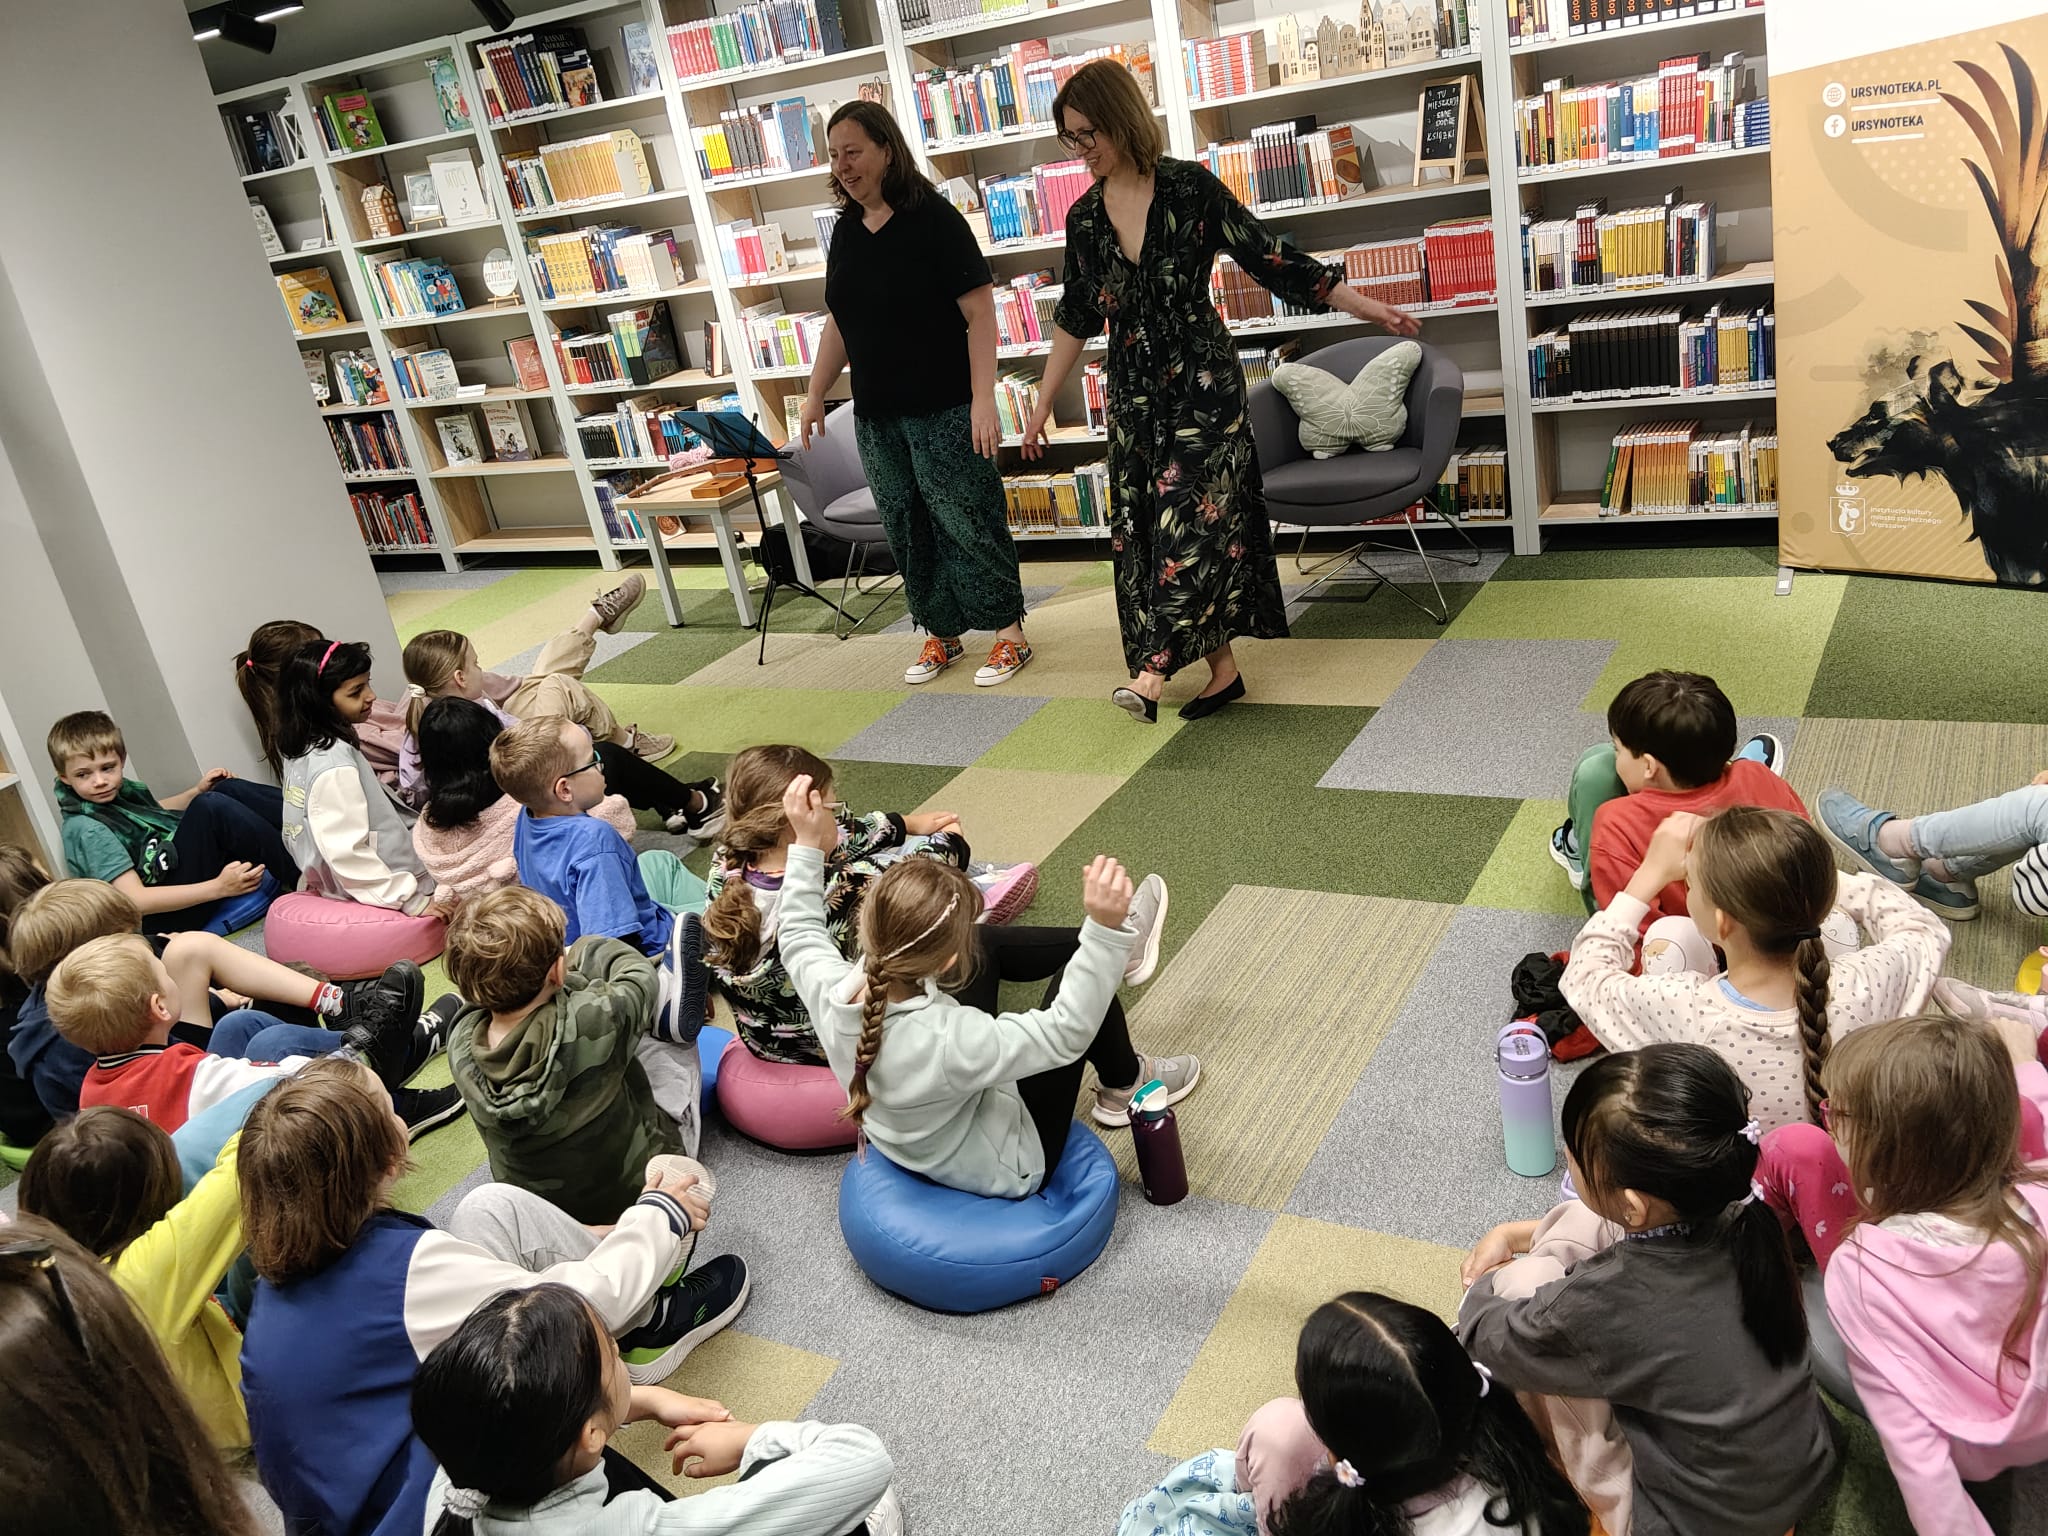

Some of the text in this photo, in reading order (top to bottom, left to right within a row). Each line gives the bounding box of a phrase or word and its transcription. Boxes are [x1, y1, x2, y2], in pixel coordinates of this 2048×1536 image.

[1572, 0, 1580, 22] otop
[1437, 90, 1447, 99] TU
[1850, 80, 1942, 98] URSYNOTEKA.PL
[1851, 116, 1924, 132] URSYNOTEKA
[424, 270, 450, 280] SZKLNE
[432, 290, 458, 305] LIFE
